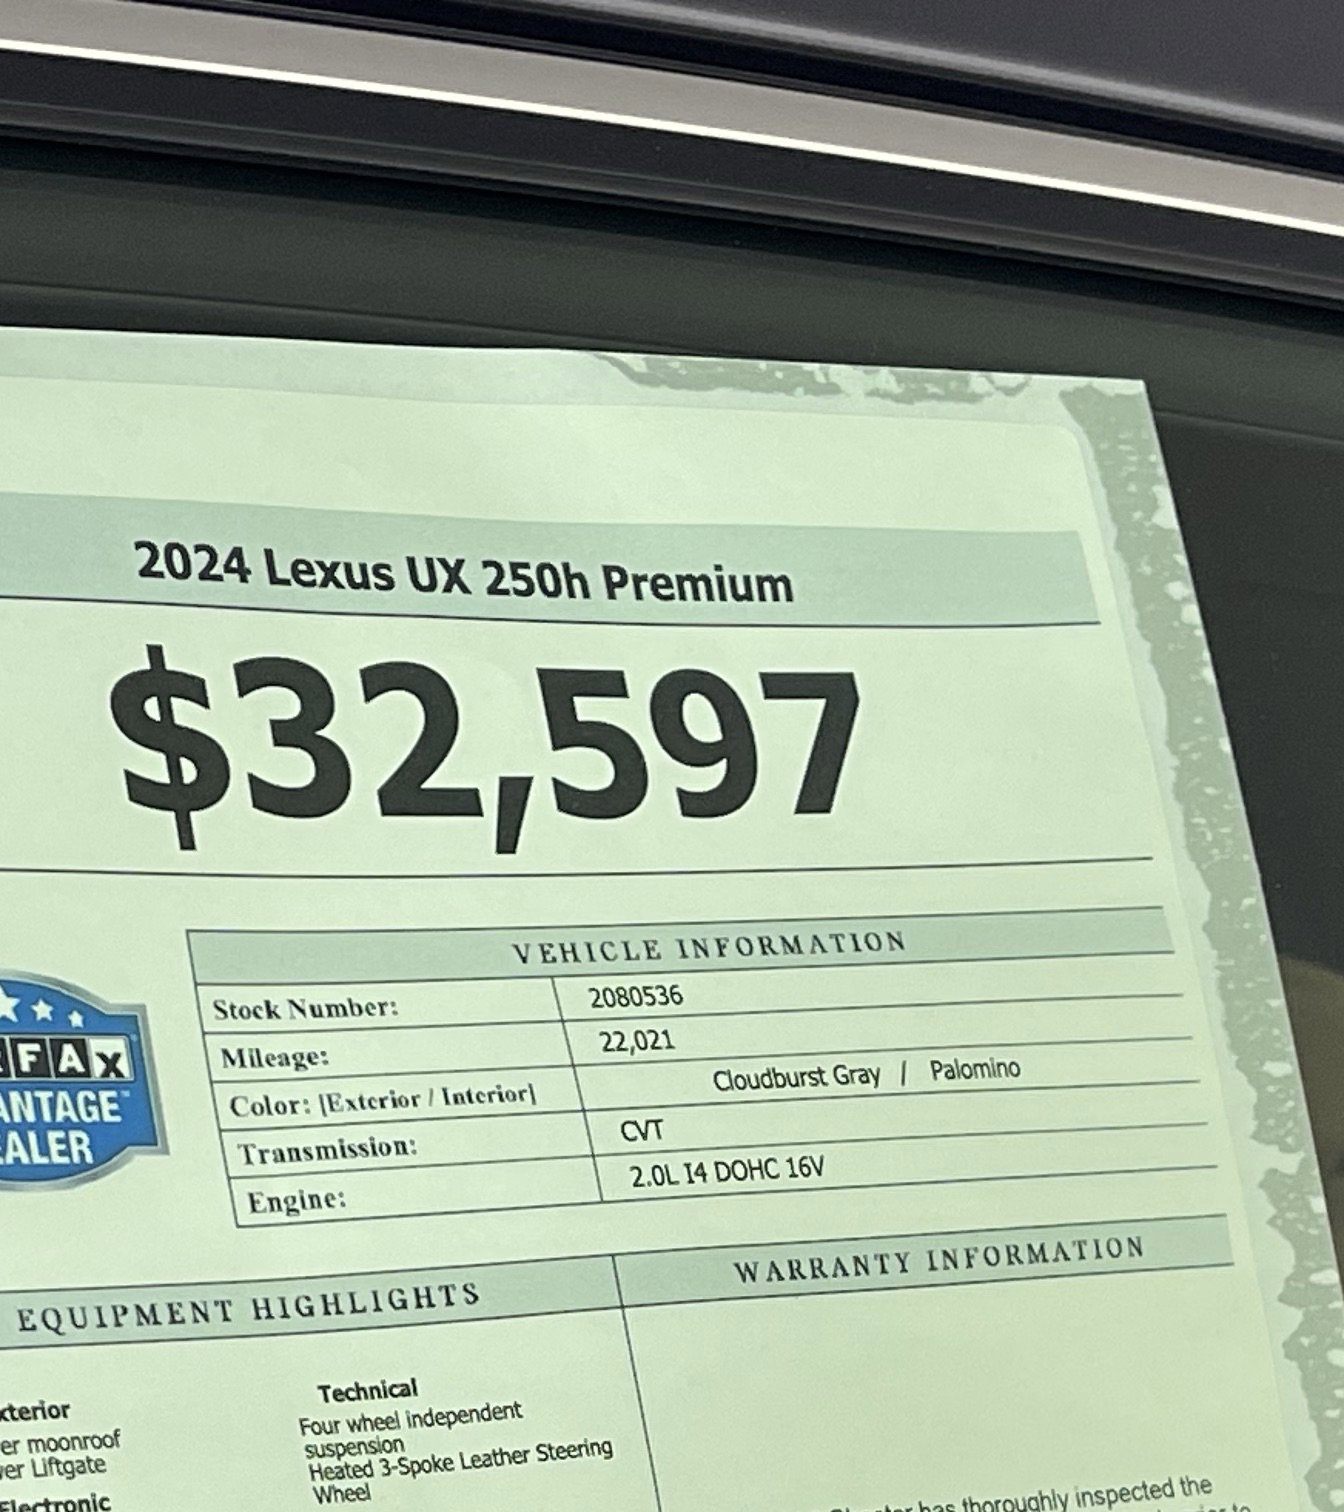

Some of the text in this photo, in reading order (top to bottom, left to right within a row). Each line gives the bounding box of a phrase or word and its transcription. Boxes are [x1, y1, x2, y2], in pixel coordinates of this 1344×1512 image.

[134, 541, 793, 602] 2024 Lexus UX 250h Premium
[111, 644, 859, 854] $32,597
[512, 931, 905, 964] VEHICLE INFORMATION
[213, 998, 398, 1020] Stock Number:
[589, 985, 683, 1008] 2080536
[599, 1029, 675, 1056] 22,021
[222, 1048, 328, 1071] Mileage:
[714, 1067, 828, 1091] Cloudburst
[833, 1065, 880, 1088] Gray
[930, 1058, 1020, 1080] Palomino
[230, 1095, 310, 1117] Color:
[621, 1119, 663, 1142] CVT
[238, 1137, 416, 1165] Transmission:
[630, 1164, 679, 1187] 2.0L
[714, 1158, 780, 1182] DOHC
[786, 1155, 824, 1178] 16V
[248, 1190, 345, 1216] Engine:
[733, 1236, 1142, 1283] WARRANTY INFORMATION
[17, 1283, 479, 1336] EQUIPMENT HIGHLIGHTS
[317, 1378, 418, 1403] Technical
[299, 1401, 523, 1436] Four wheel independent
[27, 1429, 120, 1453] moonroof
[305, 1438, 405, 1461] suspension
[31, 1456, 106, 1480] Liftgate
[309, 1439, 613, 1481] Heated 3-Spoke Leather Steering
[313, 1483, 371, 1504] Wheel
[1076, 1477, 1175, 1510] inspected
[1180, 1476, 1212, 1496] the
